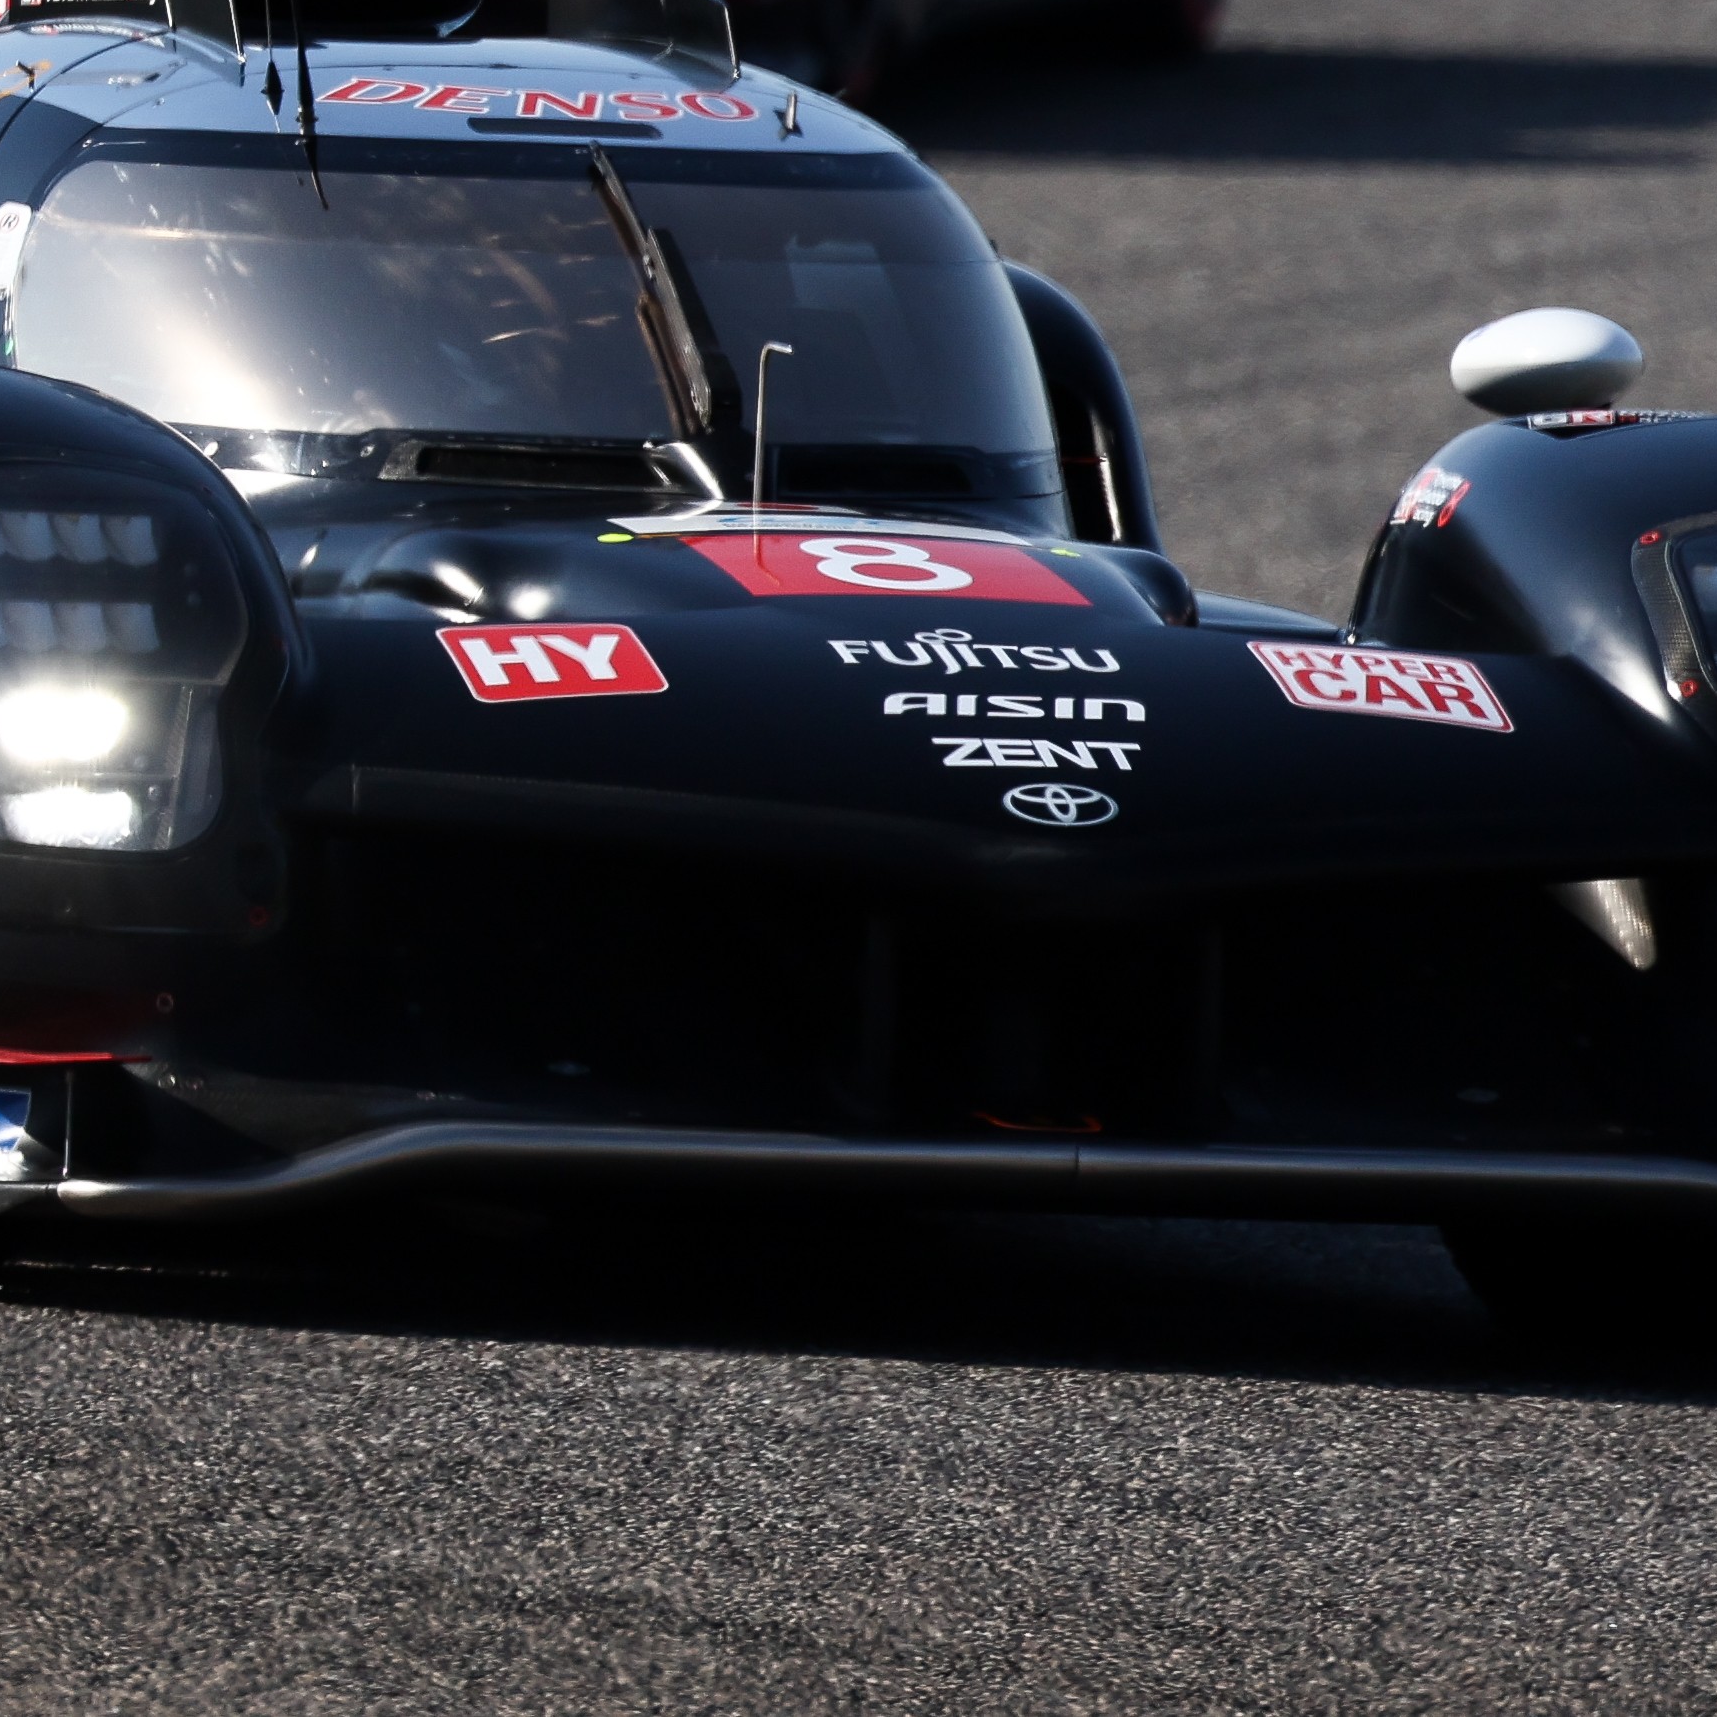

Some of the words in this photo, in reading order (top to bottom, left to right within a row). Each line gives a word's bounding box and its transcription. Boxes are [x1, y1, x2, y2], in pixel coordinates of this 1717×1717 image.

[316, 79, 760, 122] DENSO
[799, 537, 974, 591] 8
[459, 633, 621, 687] HY
[828, 628, 1121, 675] FUJITSU
[1273, 650, 1465, 683] HYPER
[884, 692, 1146, 722] AISIN
[1292, 669, 1490, 720] CAR
[932, 737, 1141, 771] ZENT
